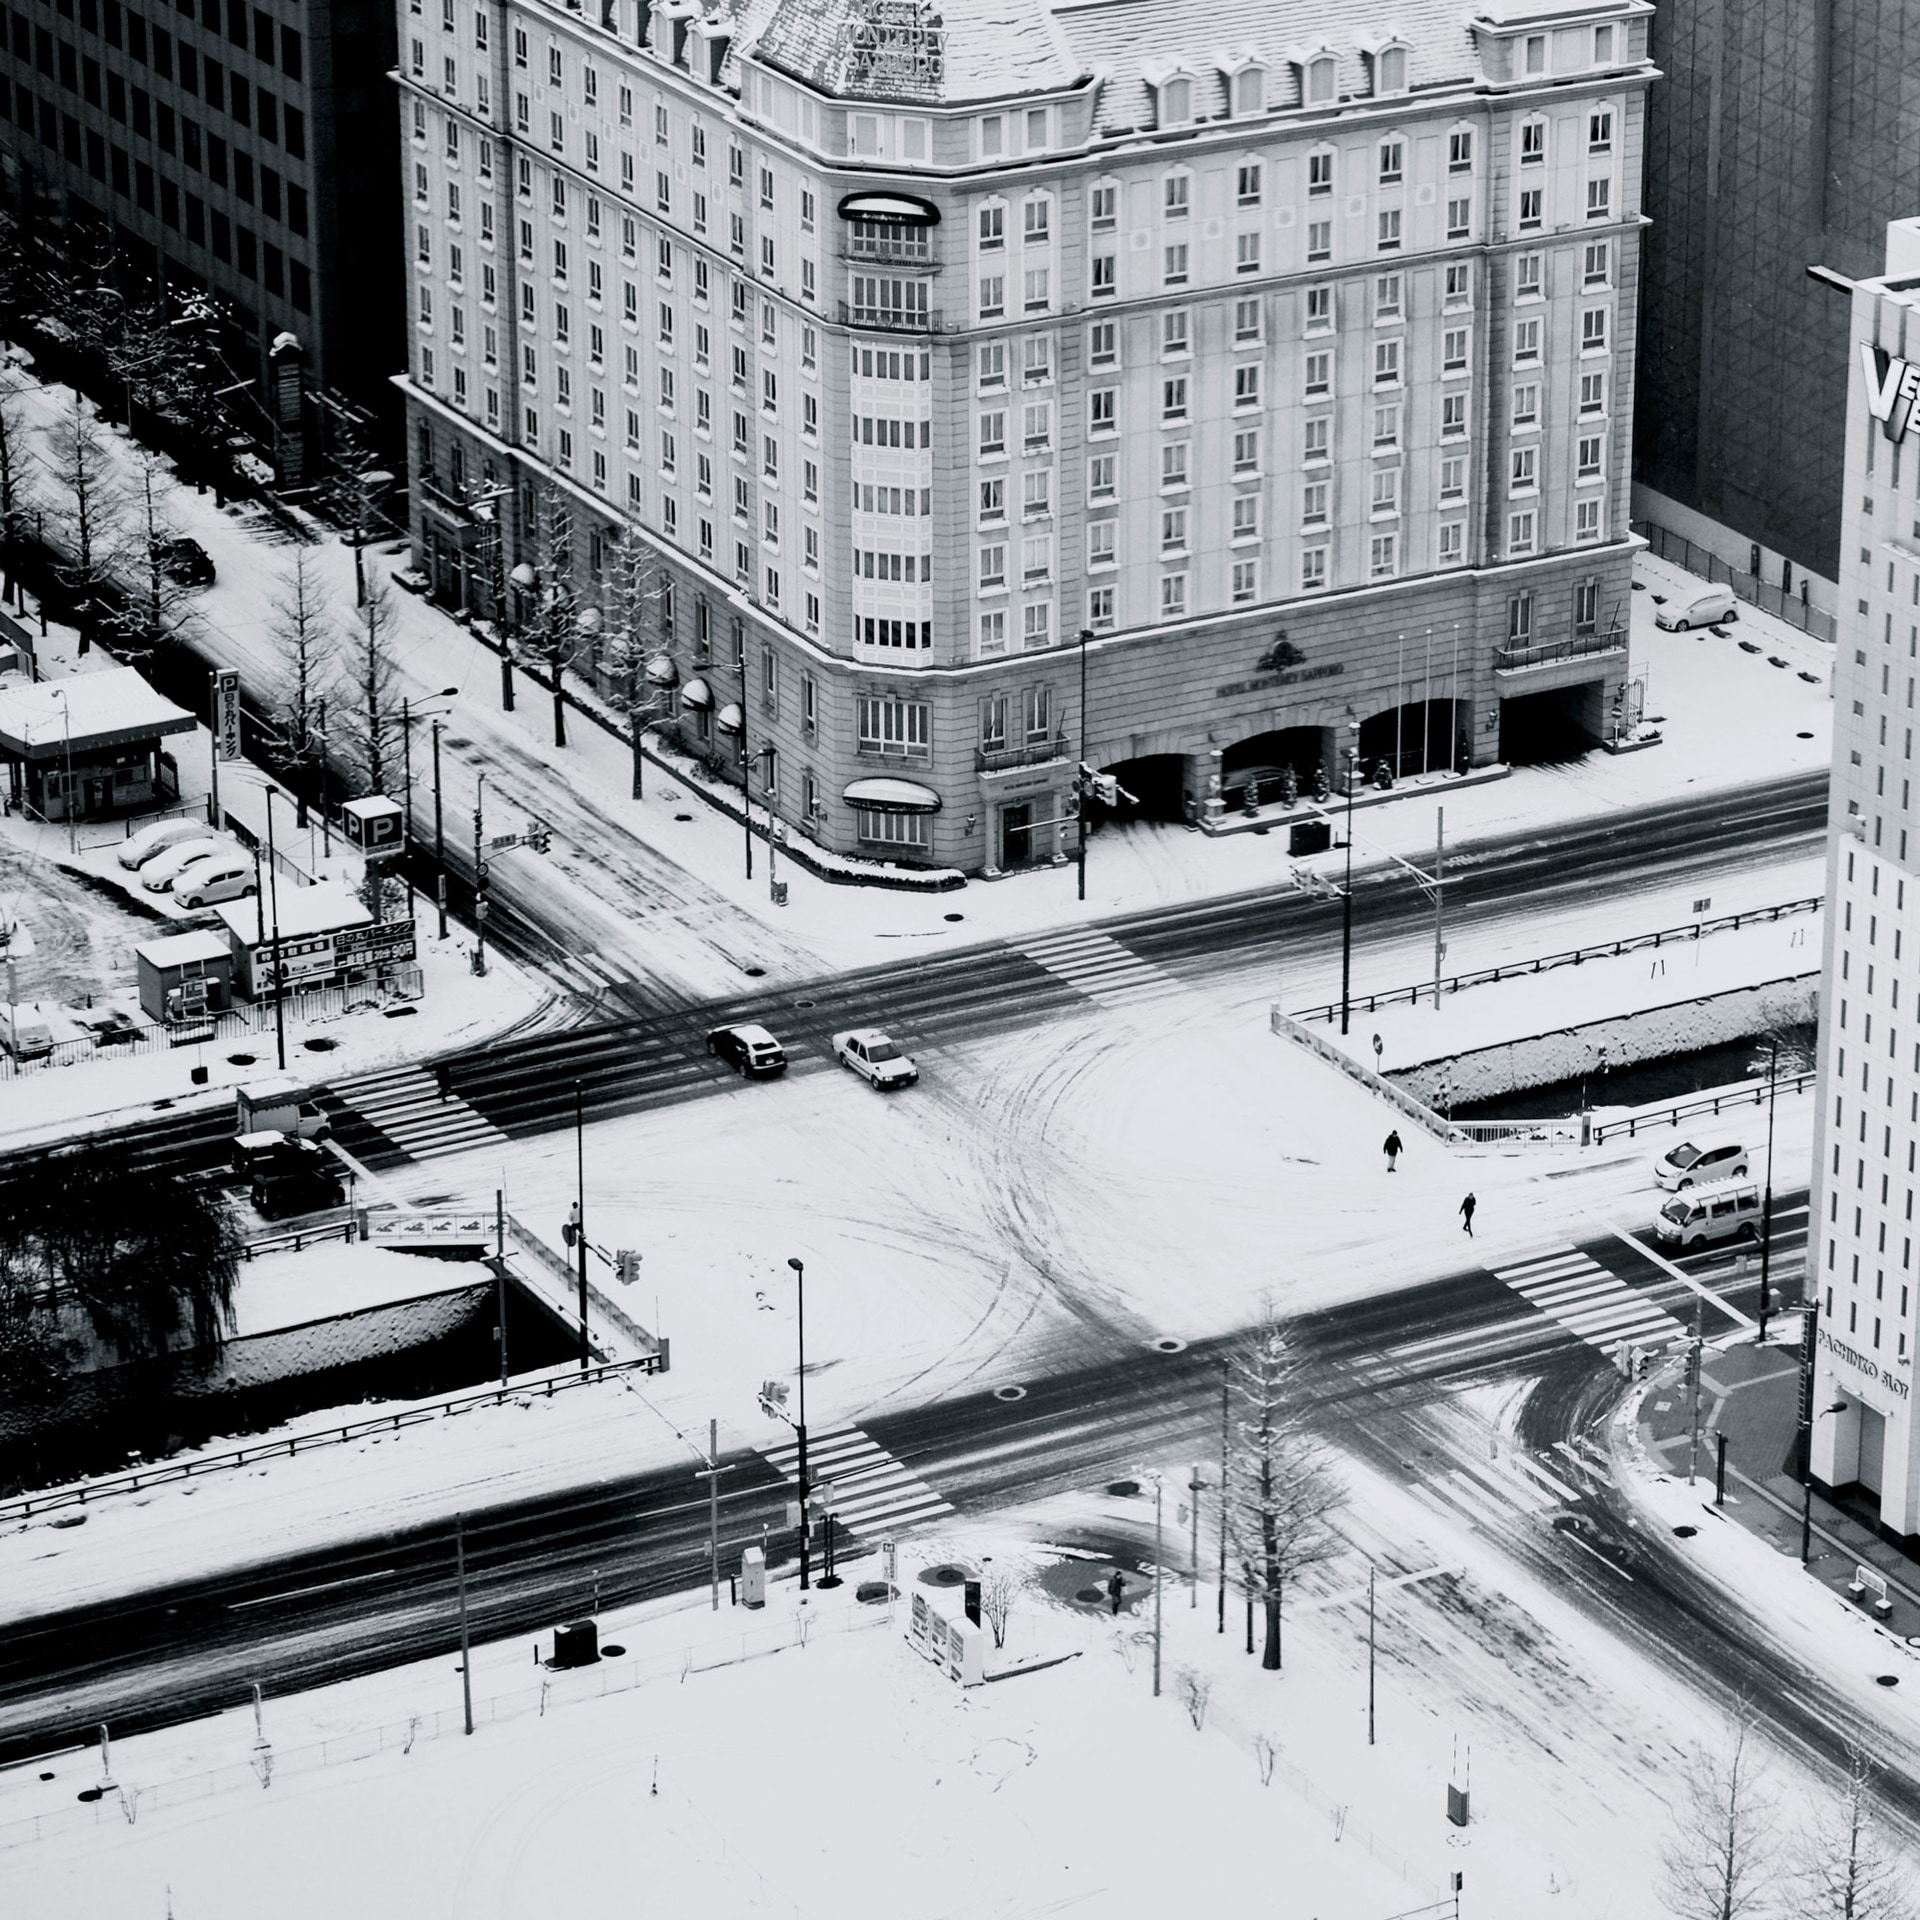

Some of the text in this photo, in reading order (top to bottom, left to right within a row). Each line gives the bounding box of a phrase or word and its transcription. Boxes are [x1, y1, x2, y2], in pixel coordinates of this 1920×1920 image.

[223, 678, 235, 692] P
[372, 817, 393, 843] P
[336, 921, 413, 946] 日の丸パーキング
[1818, 1328, 1909, 1400] PACHINKO SLOT
